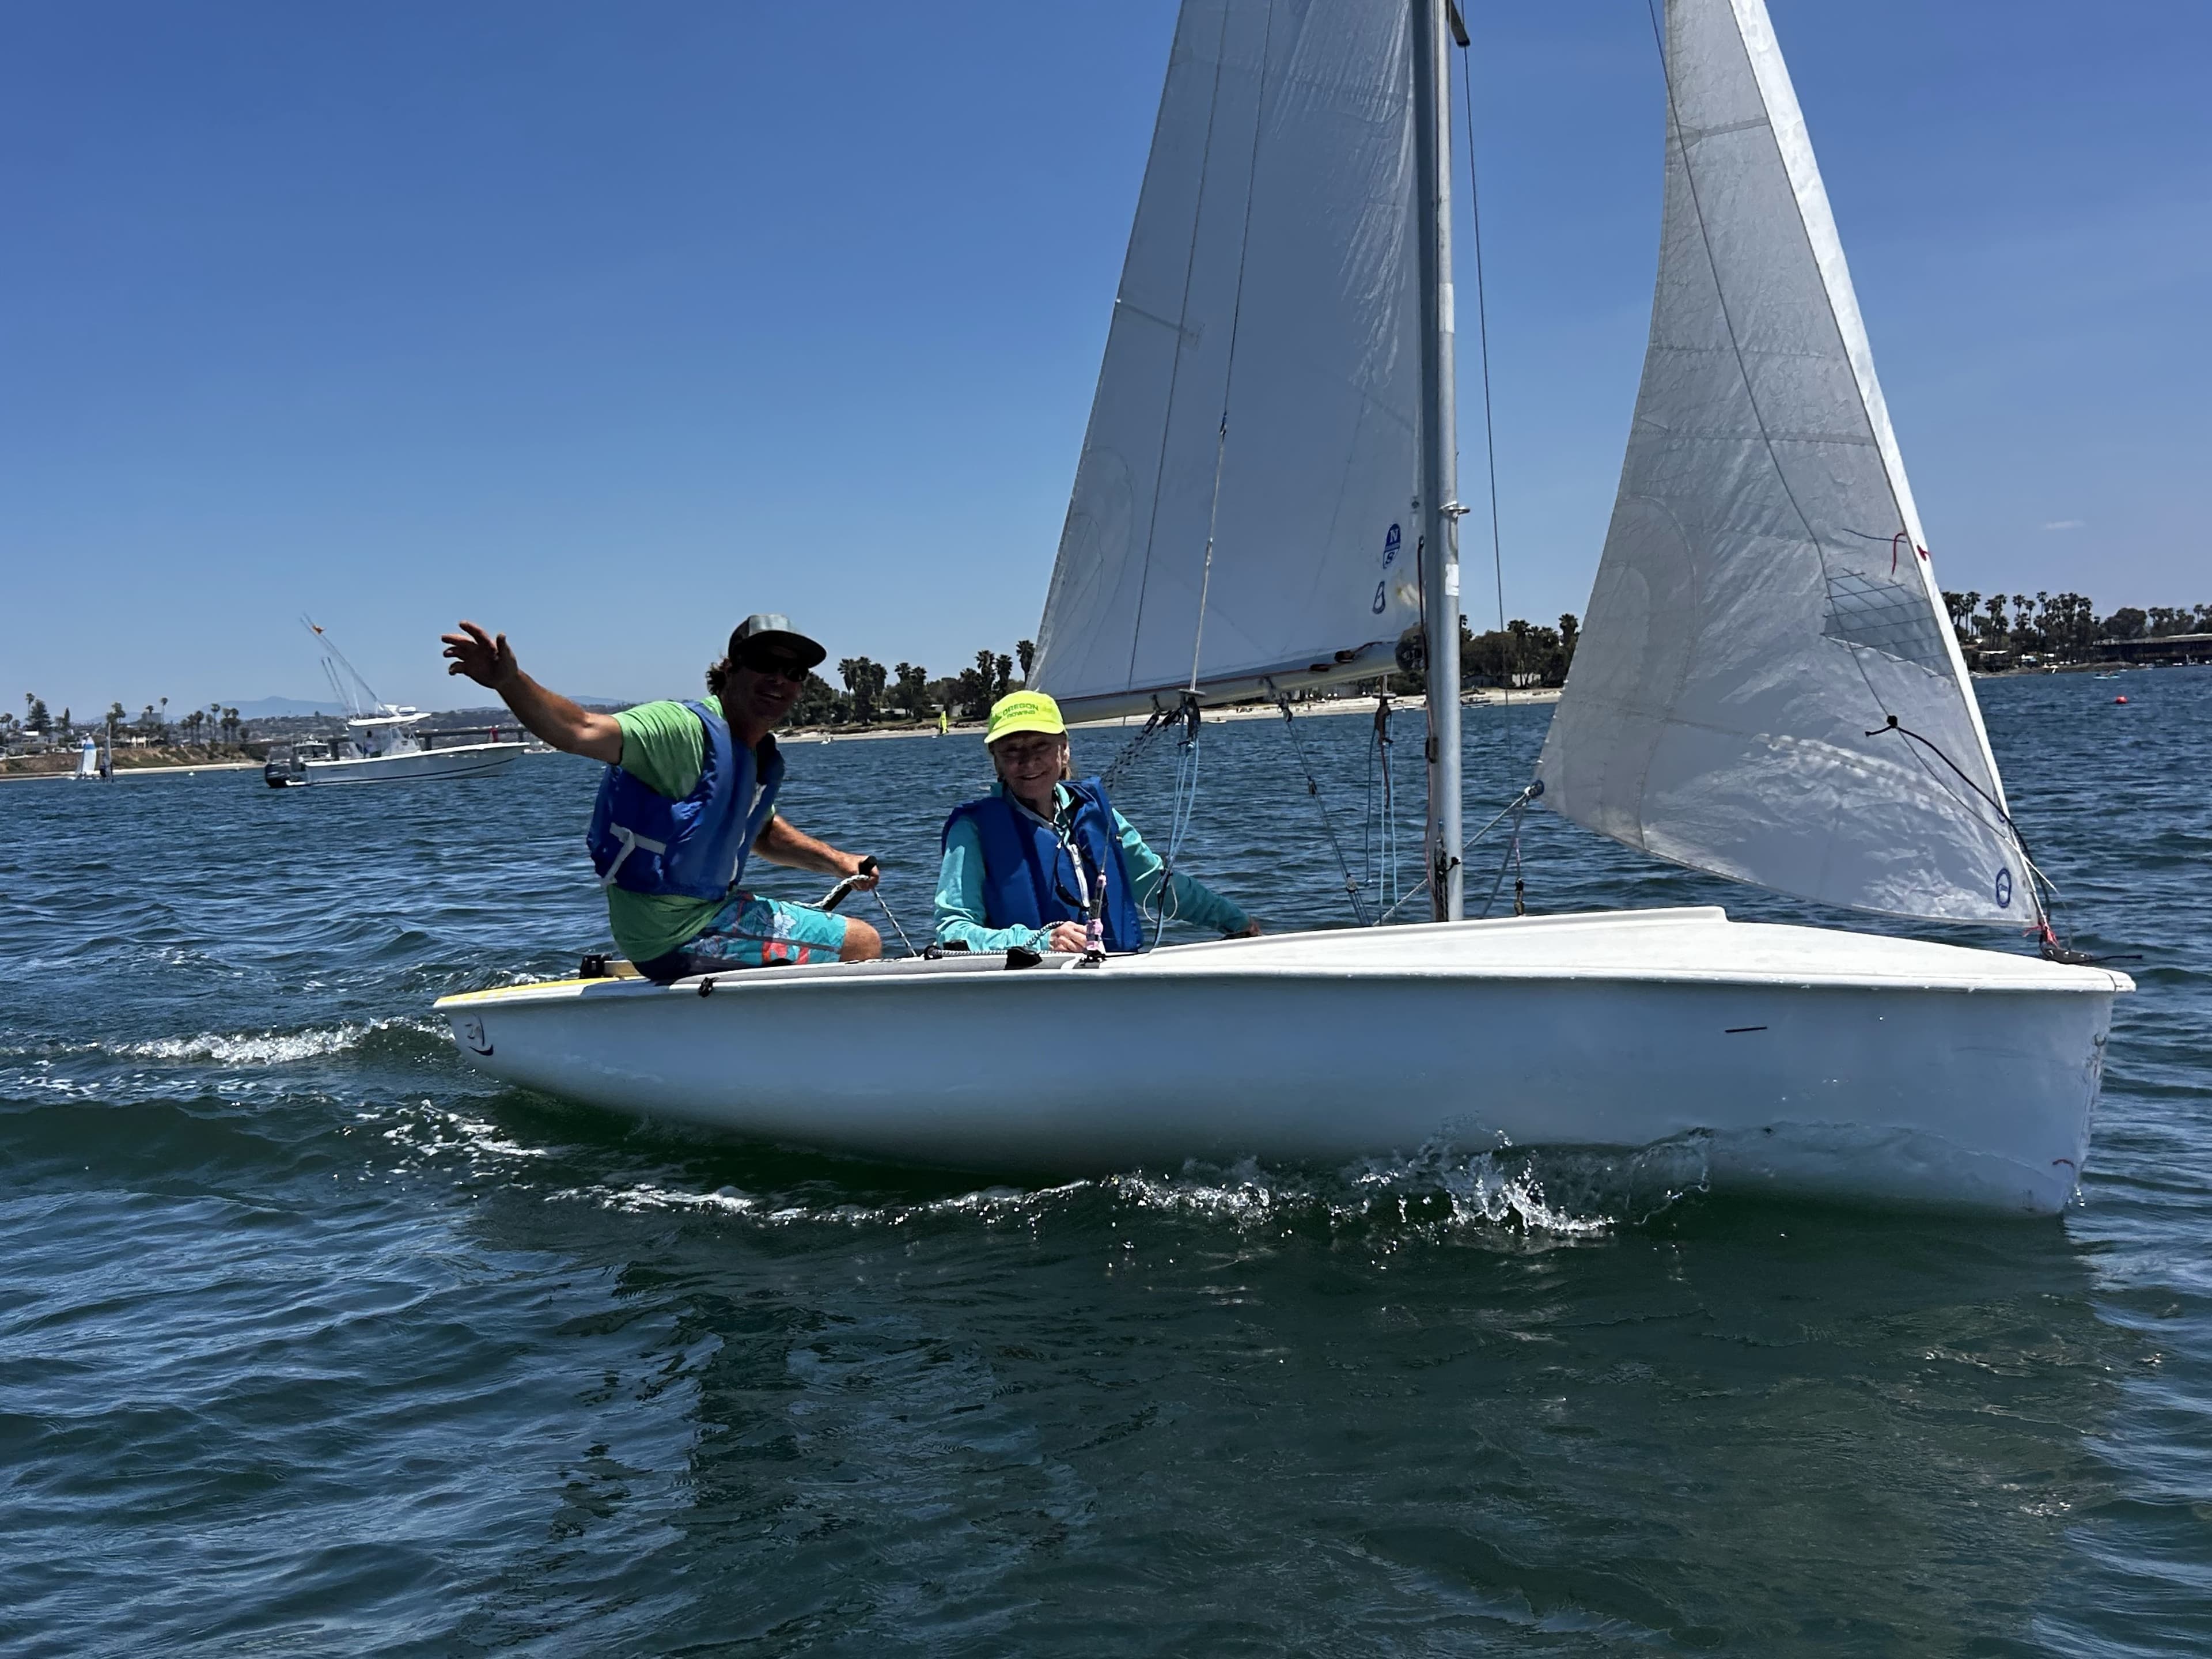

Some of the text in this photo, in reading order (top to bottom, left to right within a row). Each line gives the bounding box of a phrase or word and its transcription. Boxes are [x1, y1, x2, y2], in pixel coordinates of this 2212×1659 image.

[1389, 529, 1399, 543] N
[1385, 552, 1395, 564] S
[1003, 703, 1039, 715] OREGON
[1007, 710, 1035, 719] ROWING
